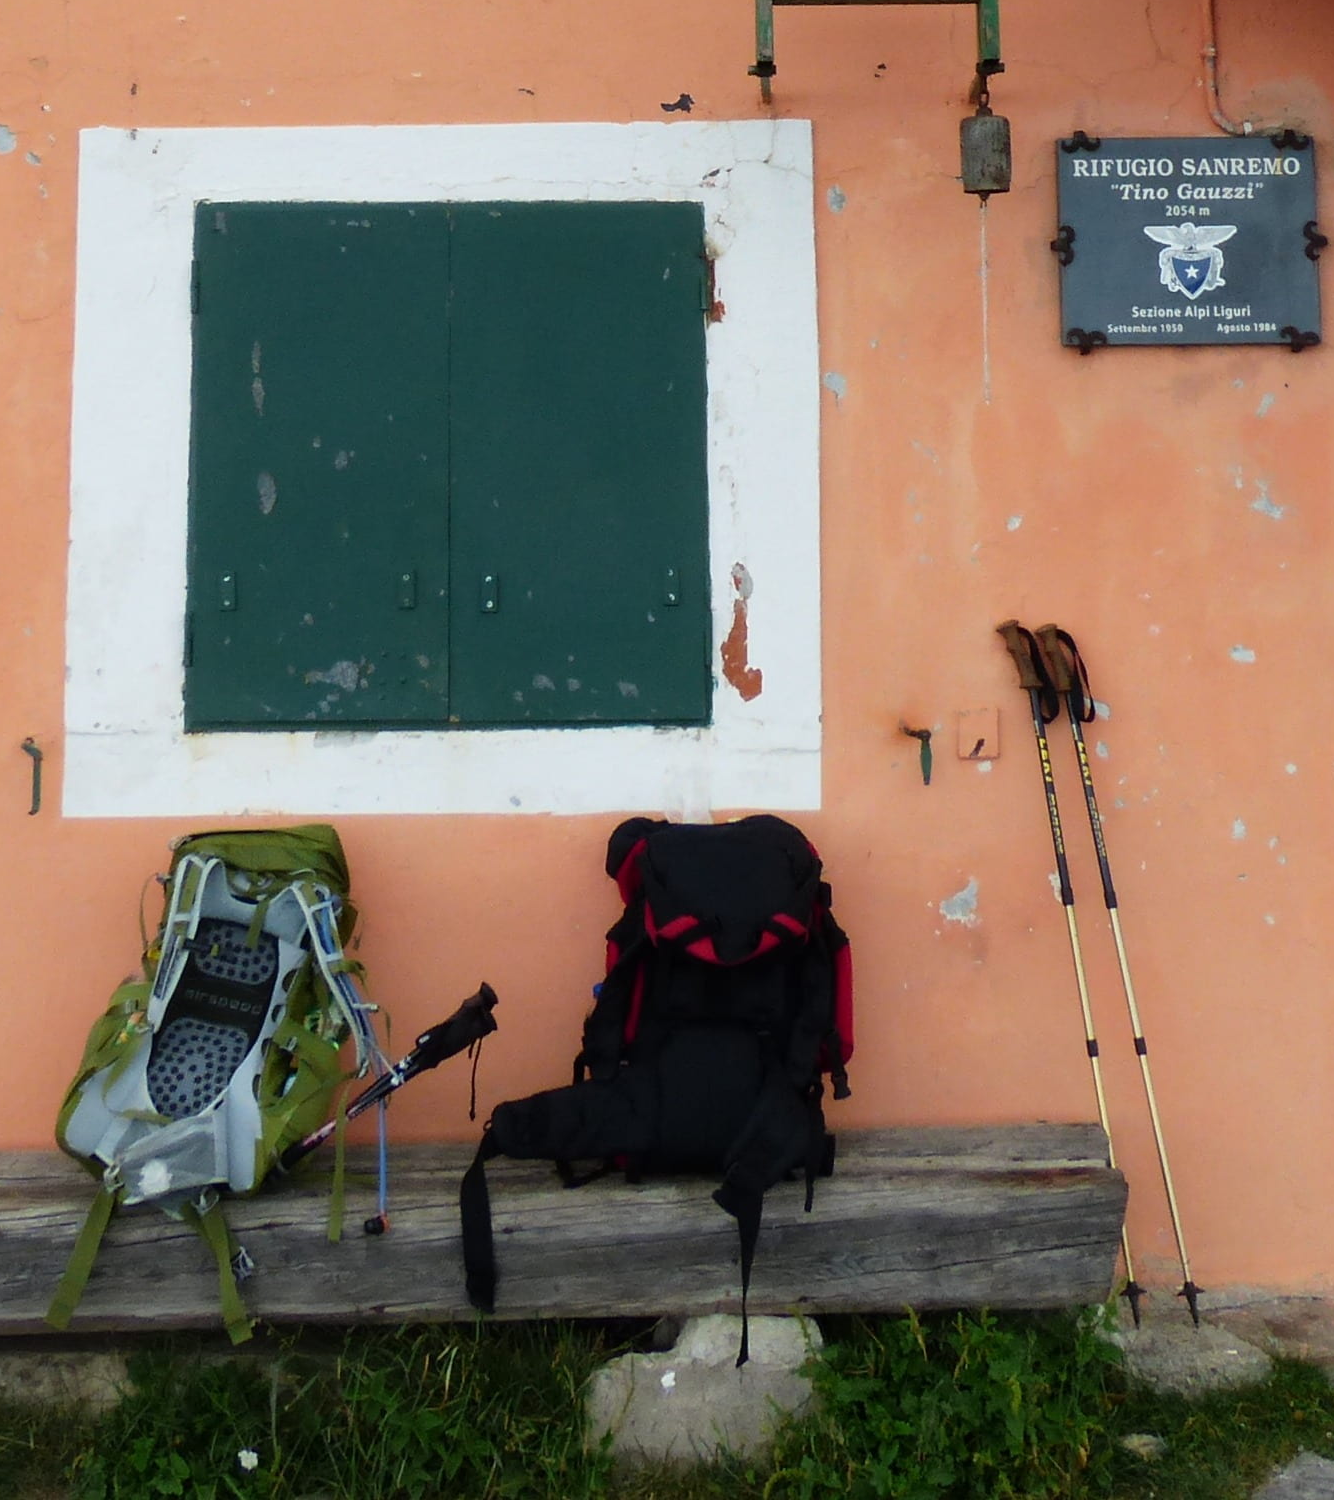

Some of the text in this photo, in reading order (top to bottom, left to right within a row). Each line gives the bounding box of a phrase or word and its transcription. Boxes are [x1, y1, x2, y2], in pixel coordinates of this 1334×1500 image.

[1073, 157, 1301, 178] RIFUGIO SANREMO
[1166, 205, 1211, 217] 2054 m
[1131, 305, 1251, 320] Sezione Alpi Liguri
[1107, 323, 1184, 333] Settembre 1950
[1217, 323, 1251, 334] Agosto
